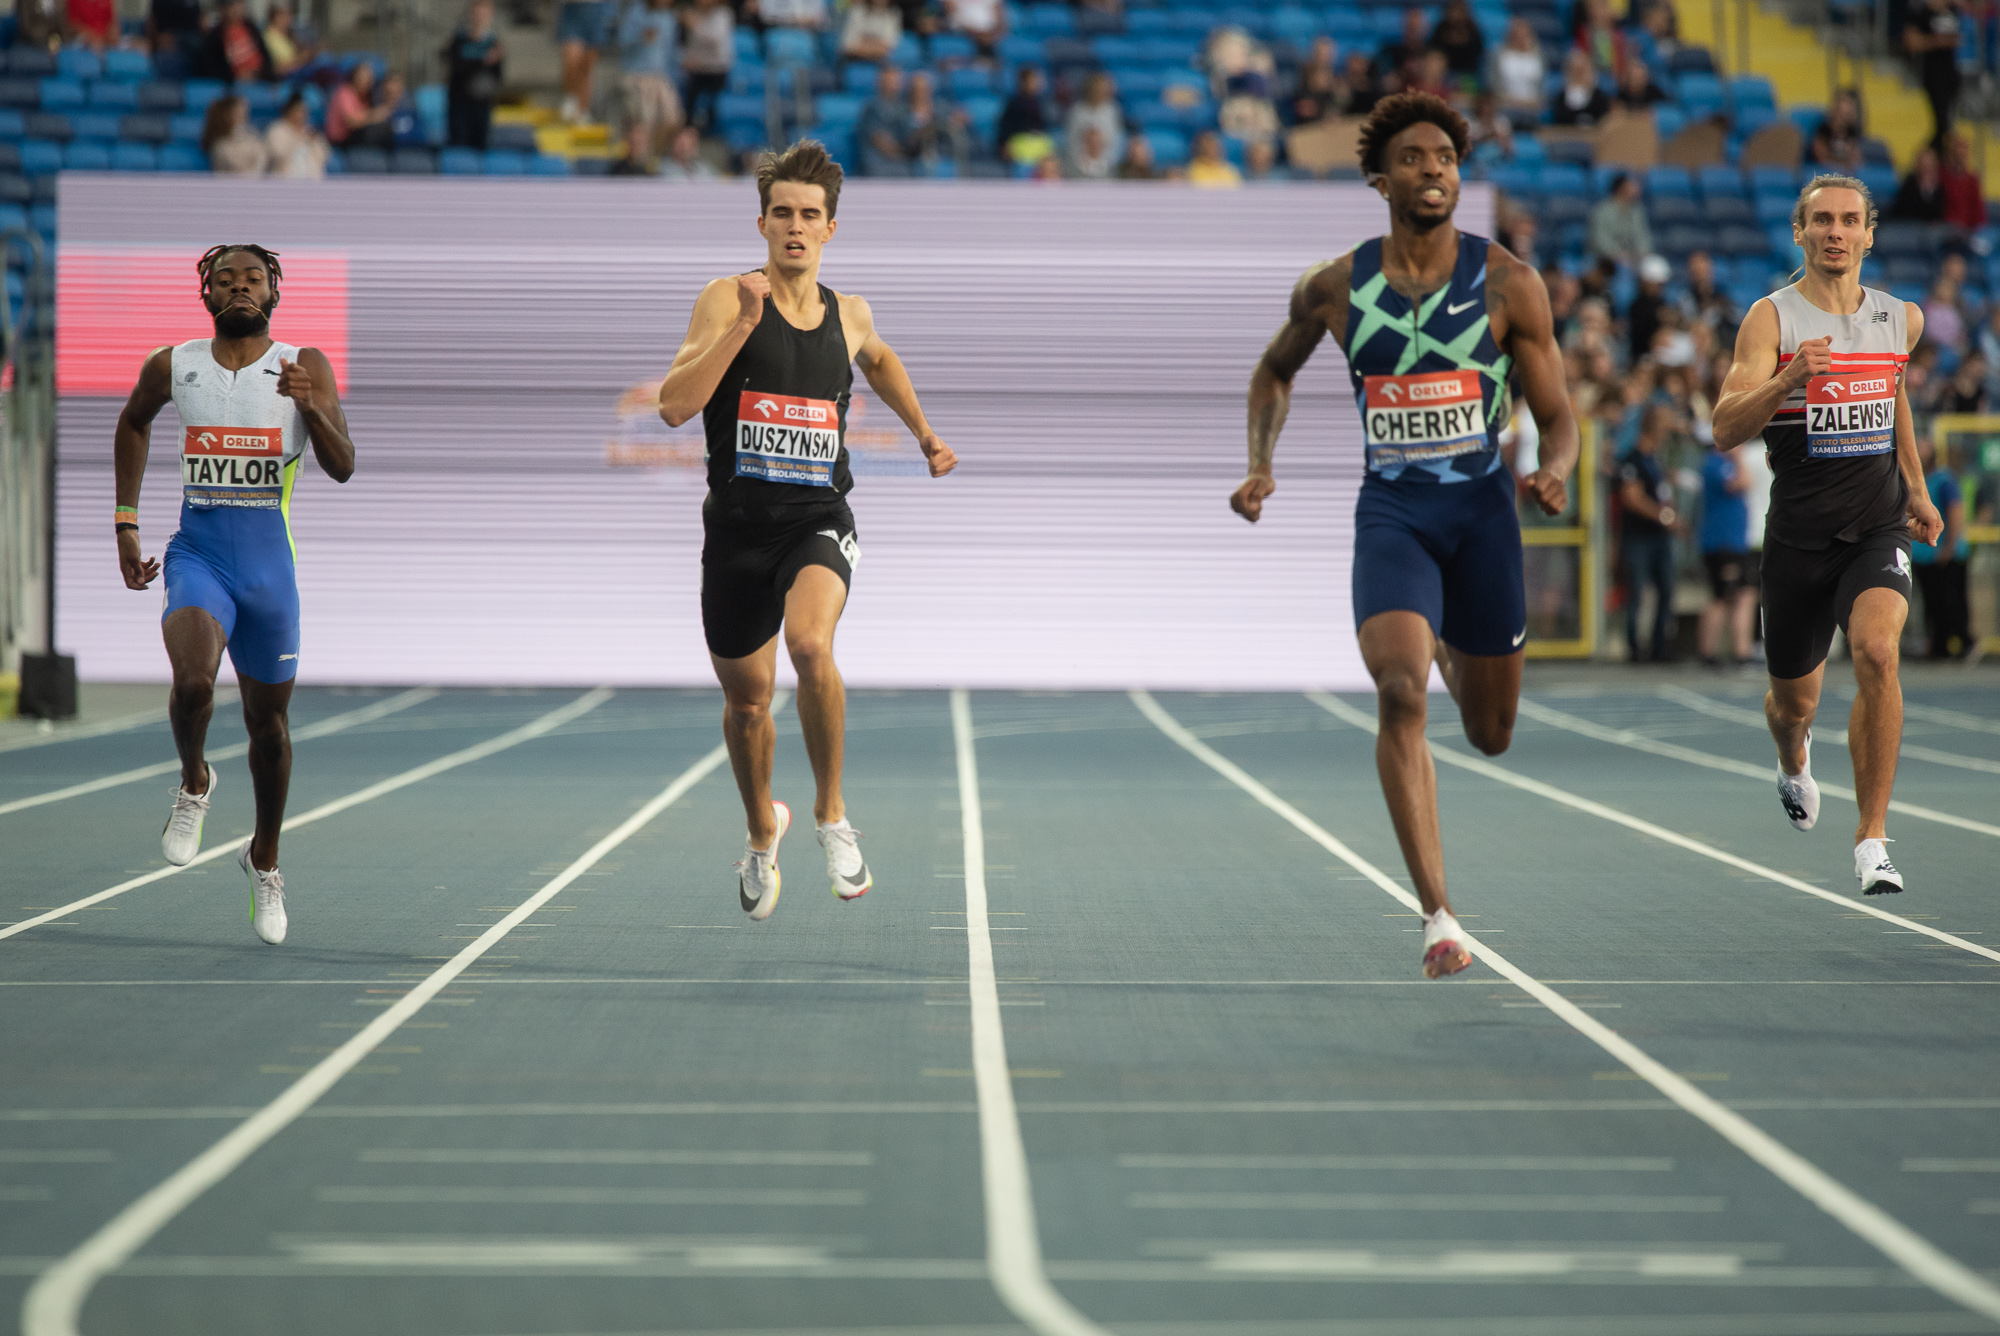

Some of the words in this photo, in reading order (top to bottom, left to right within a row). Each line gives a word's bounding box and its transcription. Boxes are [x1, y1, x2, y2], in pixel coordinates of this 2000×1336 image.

[1413, 384, 1457, 397] ORLEN
[1853, 381, 1885, 392] ORLEN
[788, 407, 824, 419] ORLEN
[1811, 401, 1893, 431] ZALEWSKI
[1372, 405, 1476, 440] CHERRY
[226, 437, 266, 448] ORLEN
[741, 424, 836, 459] DUSZYŃSKI
[1812, 438, 1838, 446] LOTTO
[1839, 436, 1866, 445] SILESIA
[1812, 446, 1841, 454] KAMILI
[740, 457, 765, 466] LOTTO
[766, 460, 794, 470] SILESIA
[187, 457, 280, 485] TAYLOR
[740, 465, 766, 475] KAMILI
[186, 490, 209, 498] LOTTO
[209, 491, 237, 499] SILESIA
[186, 497, 210, 505] AMILI
